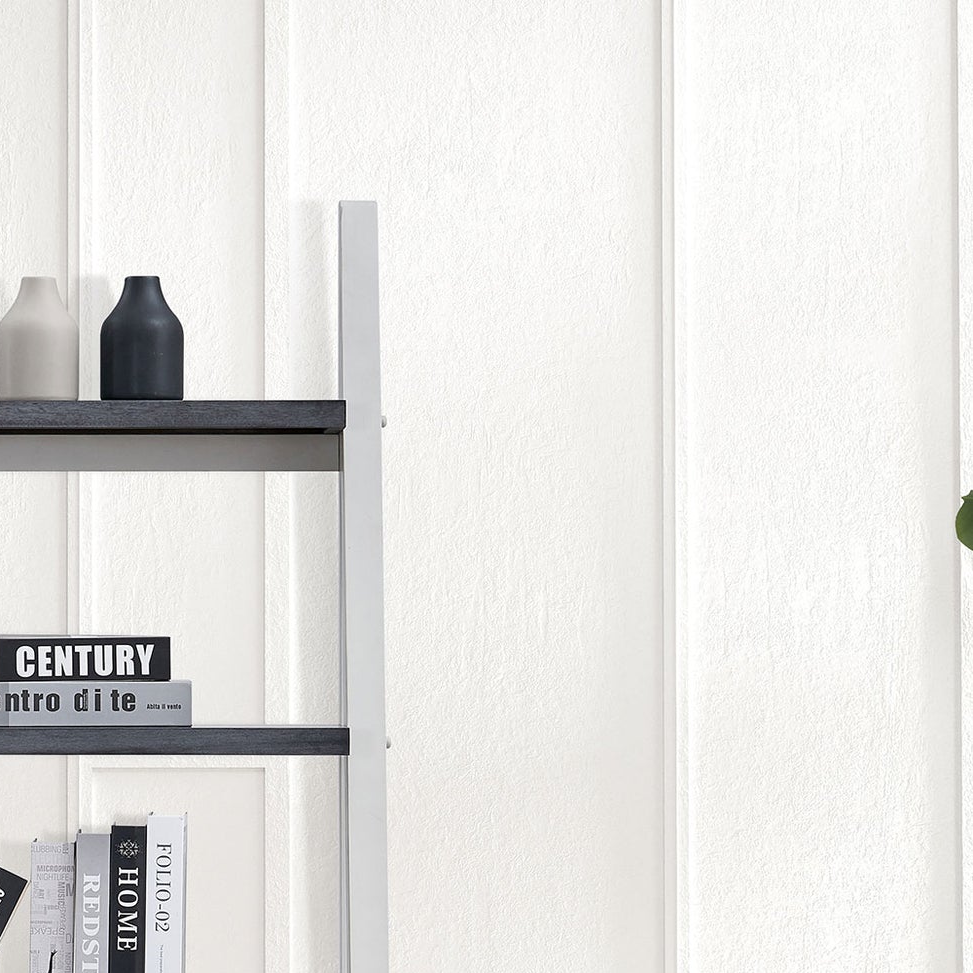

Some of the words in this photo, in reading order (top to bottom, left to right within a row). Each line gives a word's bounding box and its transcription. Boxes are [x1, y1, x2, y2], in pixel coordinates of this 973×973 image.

[16, 644, 155, 677] CENTURY
[111, 690, 136, 712] te
[117, 867, 139, 952] HOME
[154, 843, 172, 932] FOLIO-02
